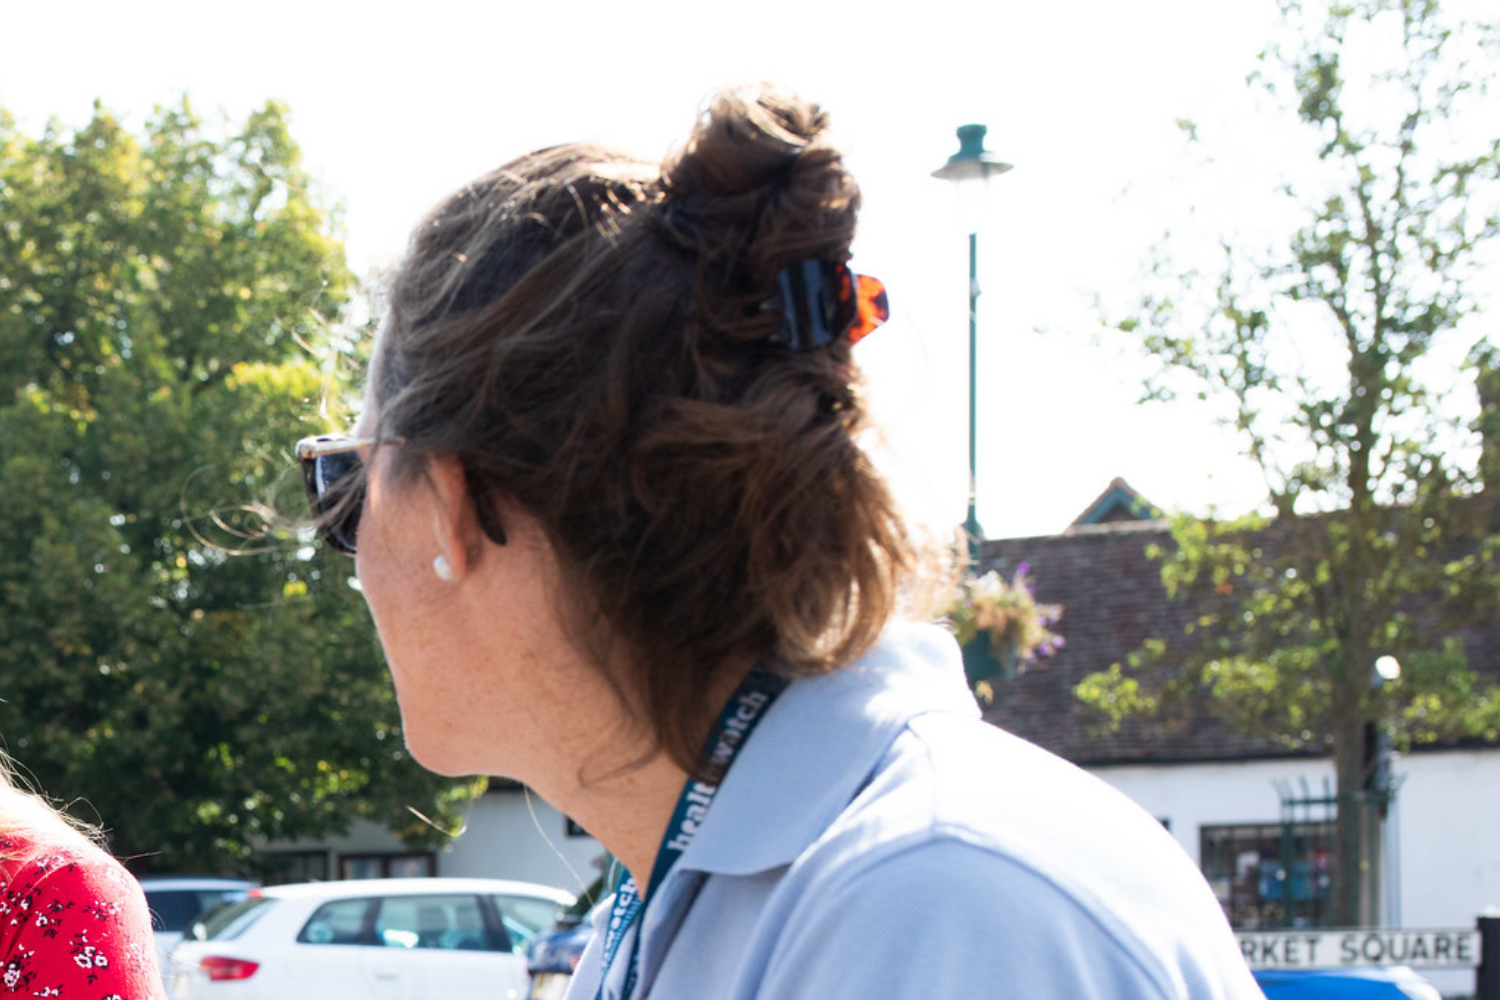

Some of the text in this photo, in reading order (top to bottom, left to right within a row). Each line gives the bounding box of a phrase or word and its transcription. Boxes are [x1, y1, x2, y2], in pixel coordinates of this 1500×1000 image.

[667, 691, 769, 851] healtwatch
[1240, 933, 1472, 963] RKET SQUARE
